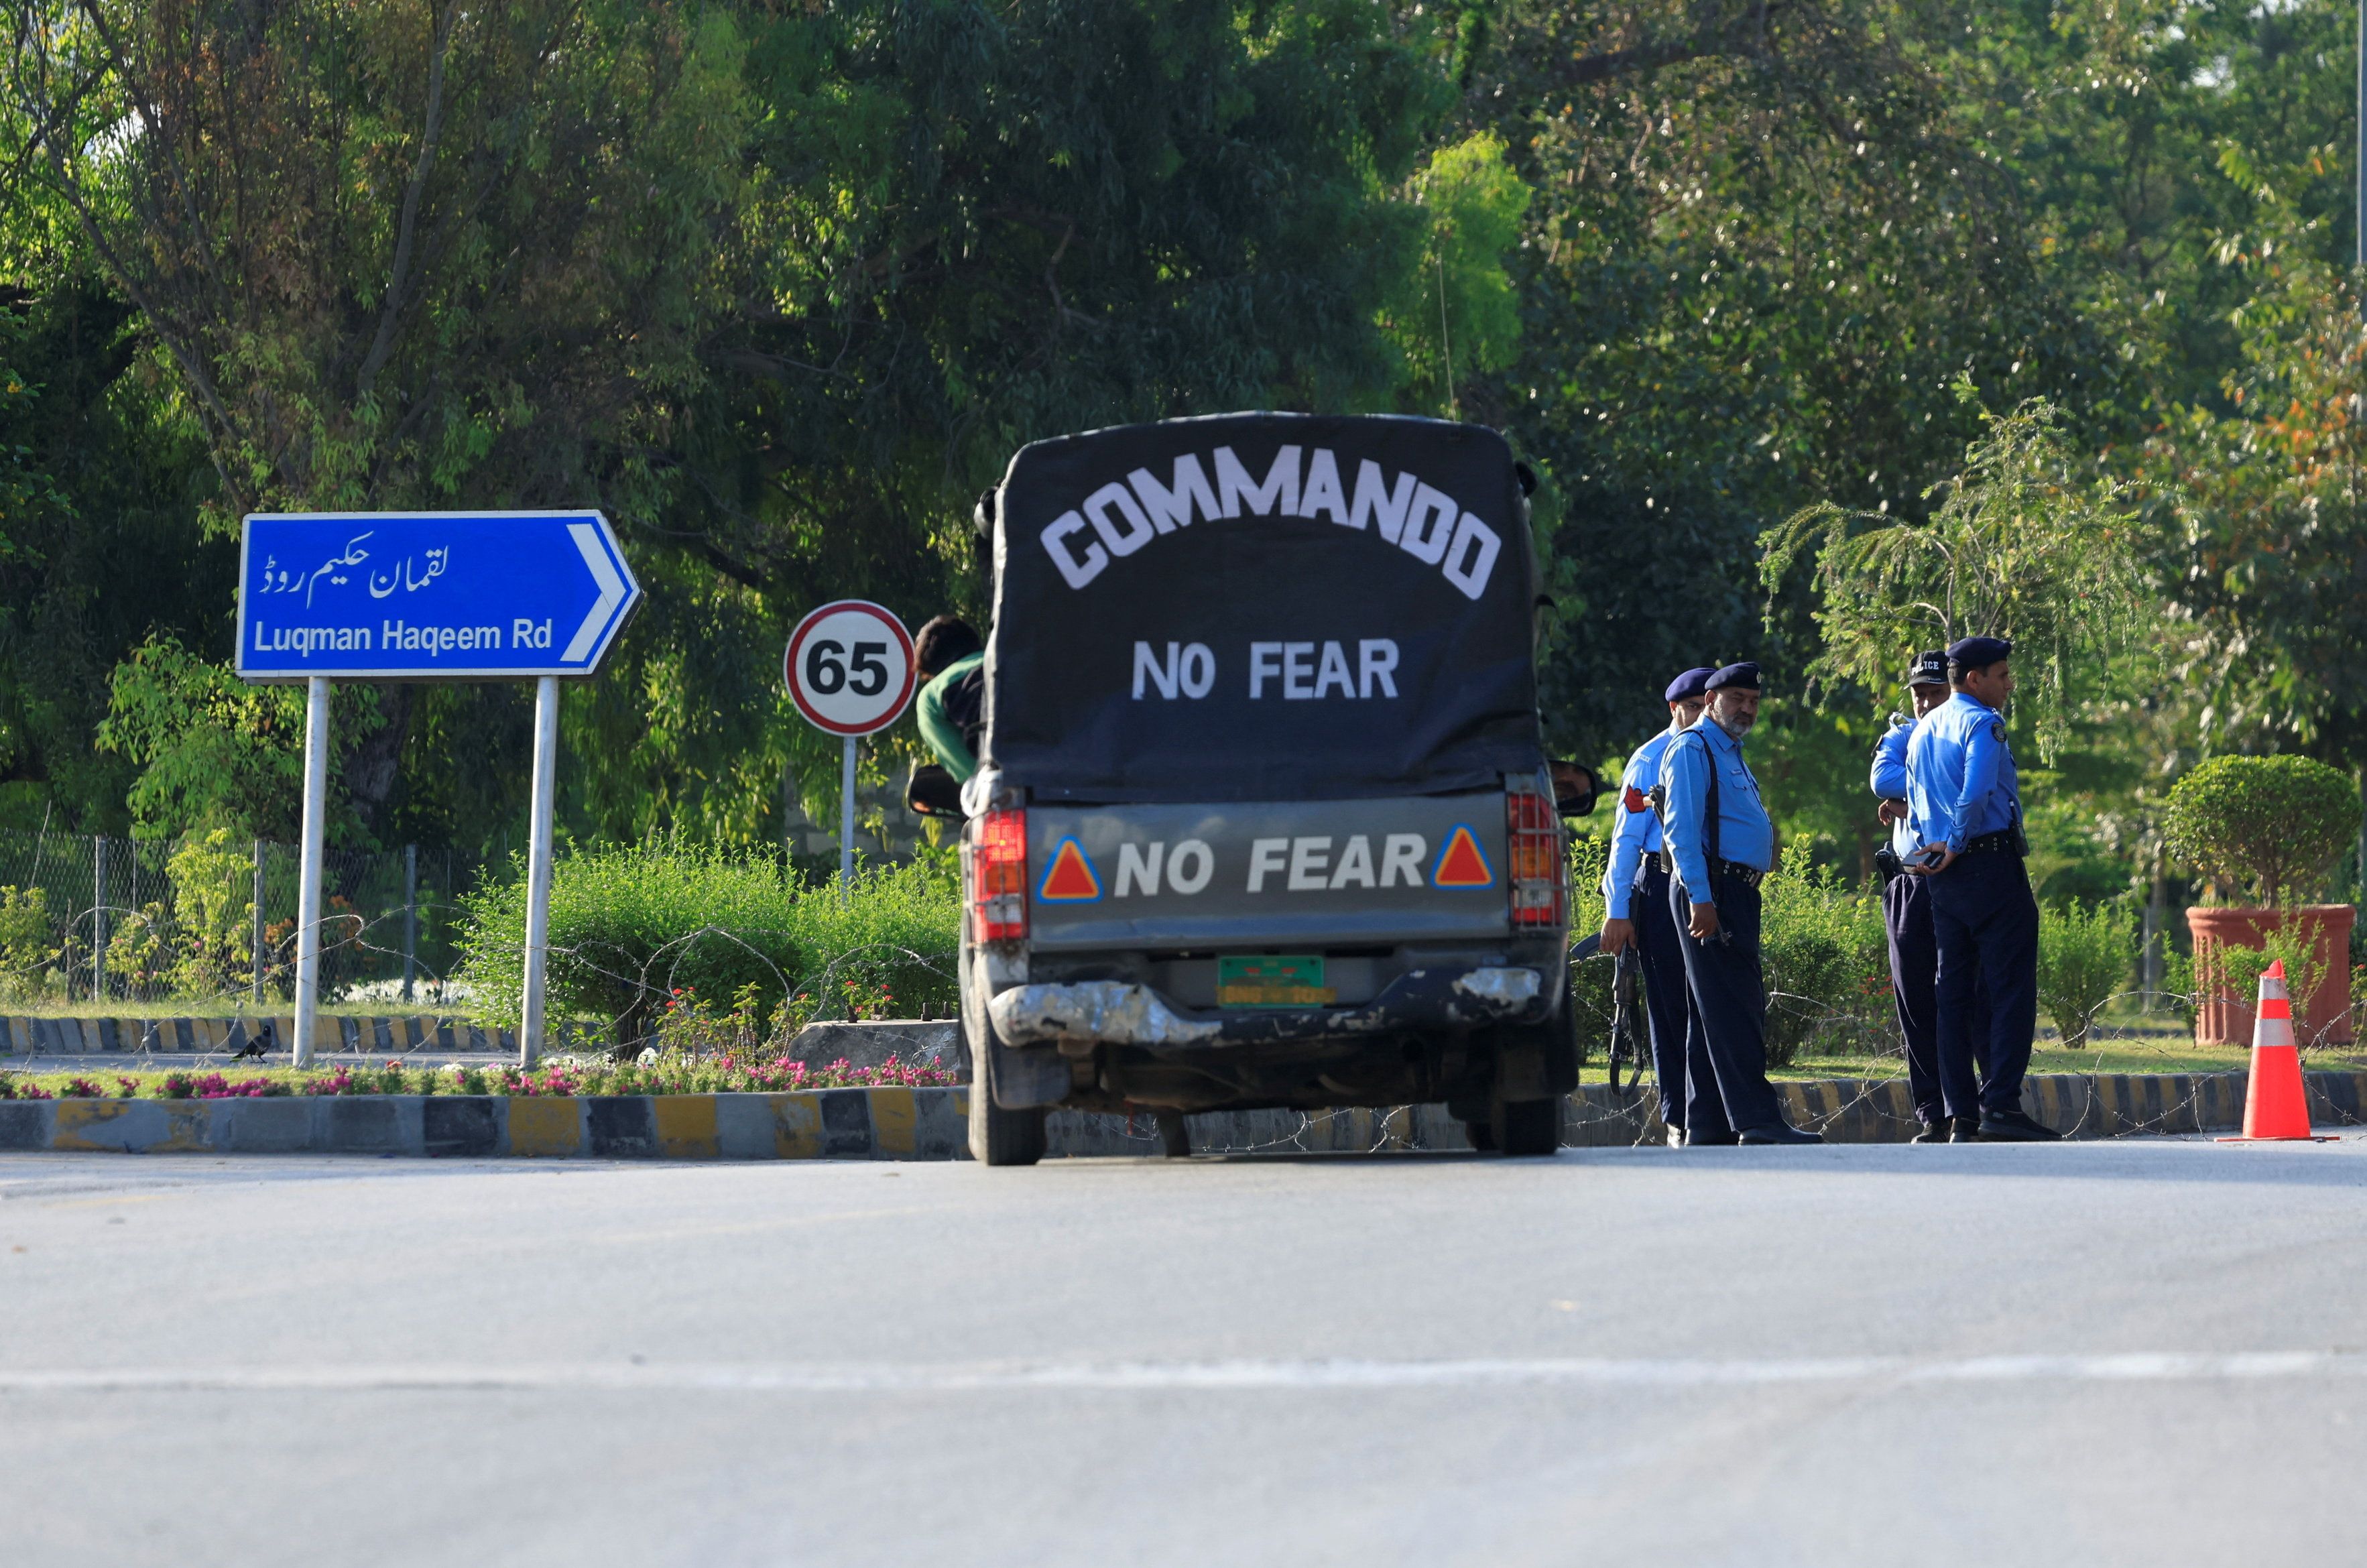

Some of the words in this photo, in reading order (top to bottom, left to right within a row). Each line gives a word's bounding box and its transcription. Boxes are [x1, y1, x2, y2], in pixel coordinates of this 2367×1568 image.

[1040, 444, 1502, 601] COMMANDO
[259, 554, 305, 593] روڈ
[306, 530, 374, 609] حکیم
[369, 545, 448, 599] لقمان
[254, 621, 371, 658] Luqman
[381, 619, 501, 657] Haqeem
[512, 618, 552, 650] Rd
[806, 640, 888, 696] 65
[1132, 641, 1215, 700] NO
[1250, 638, 1399, 699] FEAR
[1113, 838, 1215, 897] NO
[1246, 833, 1428, 893] FEAR
